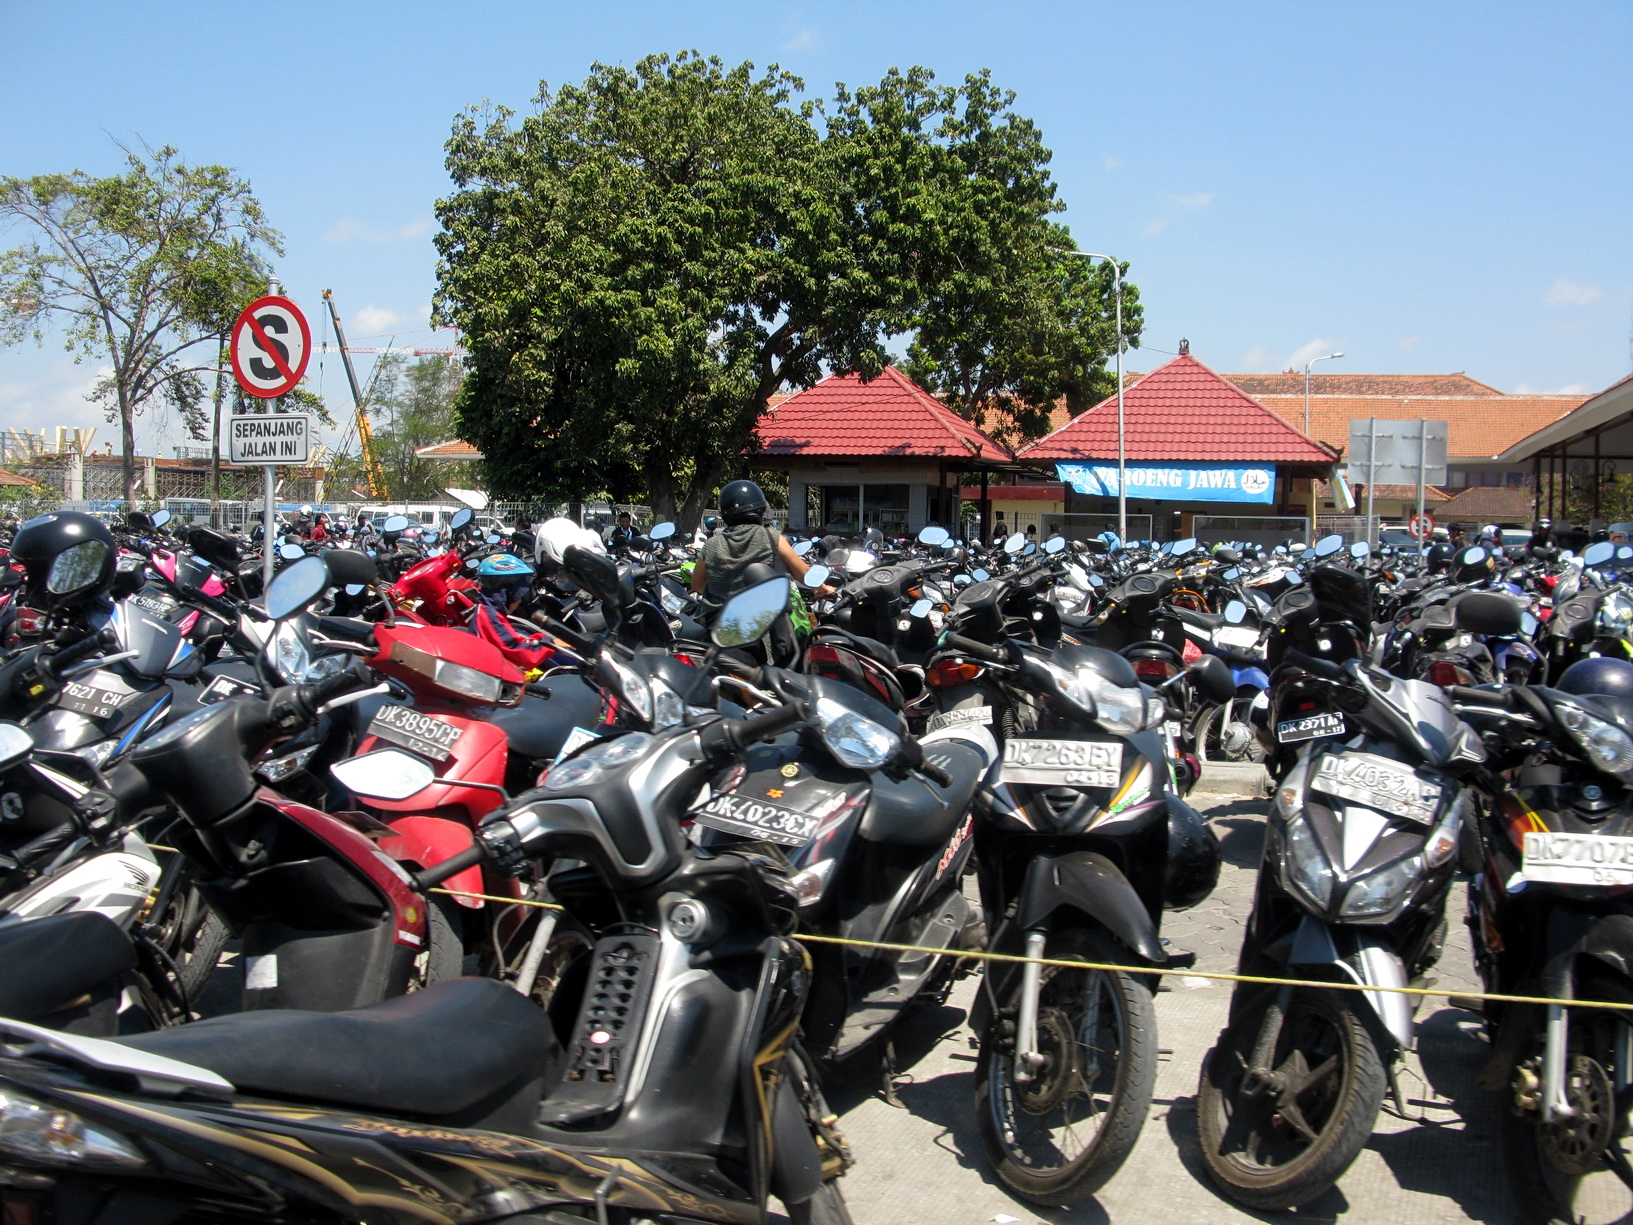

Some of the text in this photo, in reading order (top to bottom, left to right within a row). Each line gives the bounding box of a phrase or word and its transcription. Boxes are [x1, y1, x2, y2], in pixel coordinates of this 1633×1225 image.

[235, 421, 303, 438] SEPANJANG
[240, 440, 297, 458] JALAN INI
[1187, 470, 1236, 490] JAWA
[101, 692, 122, 706] CH
